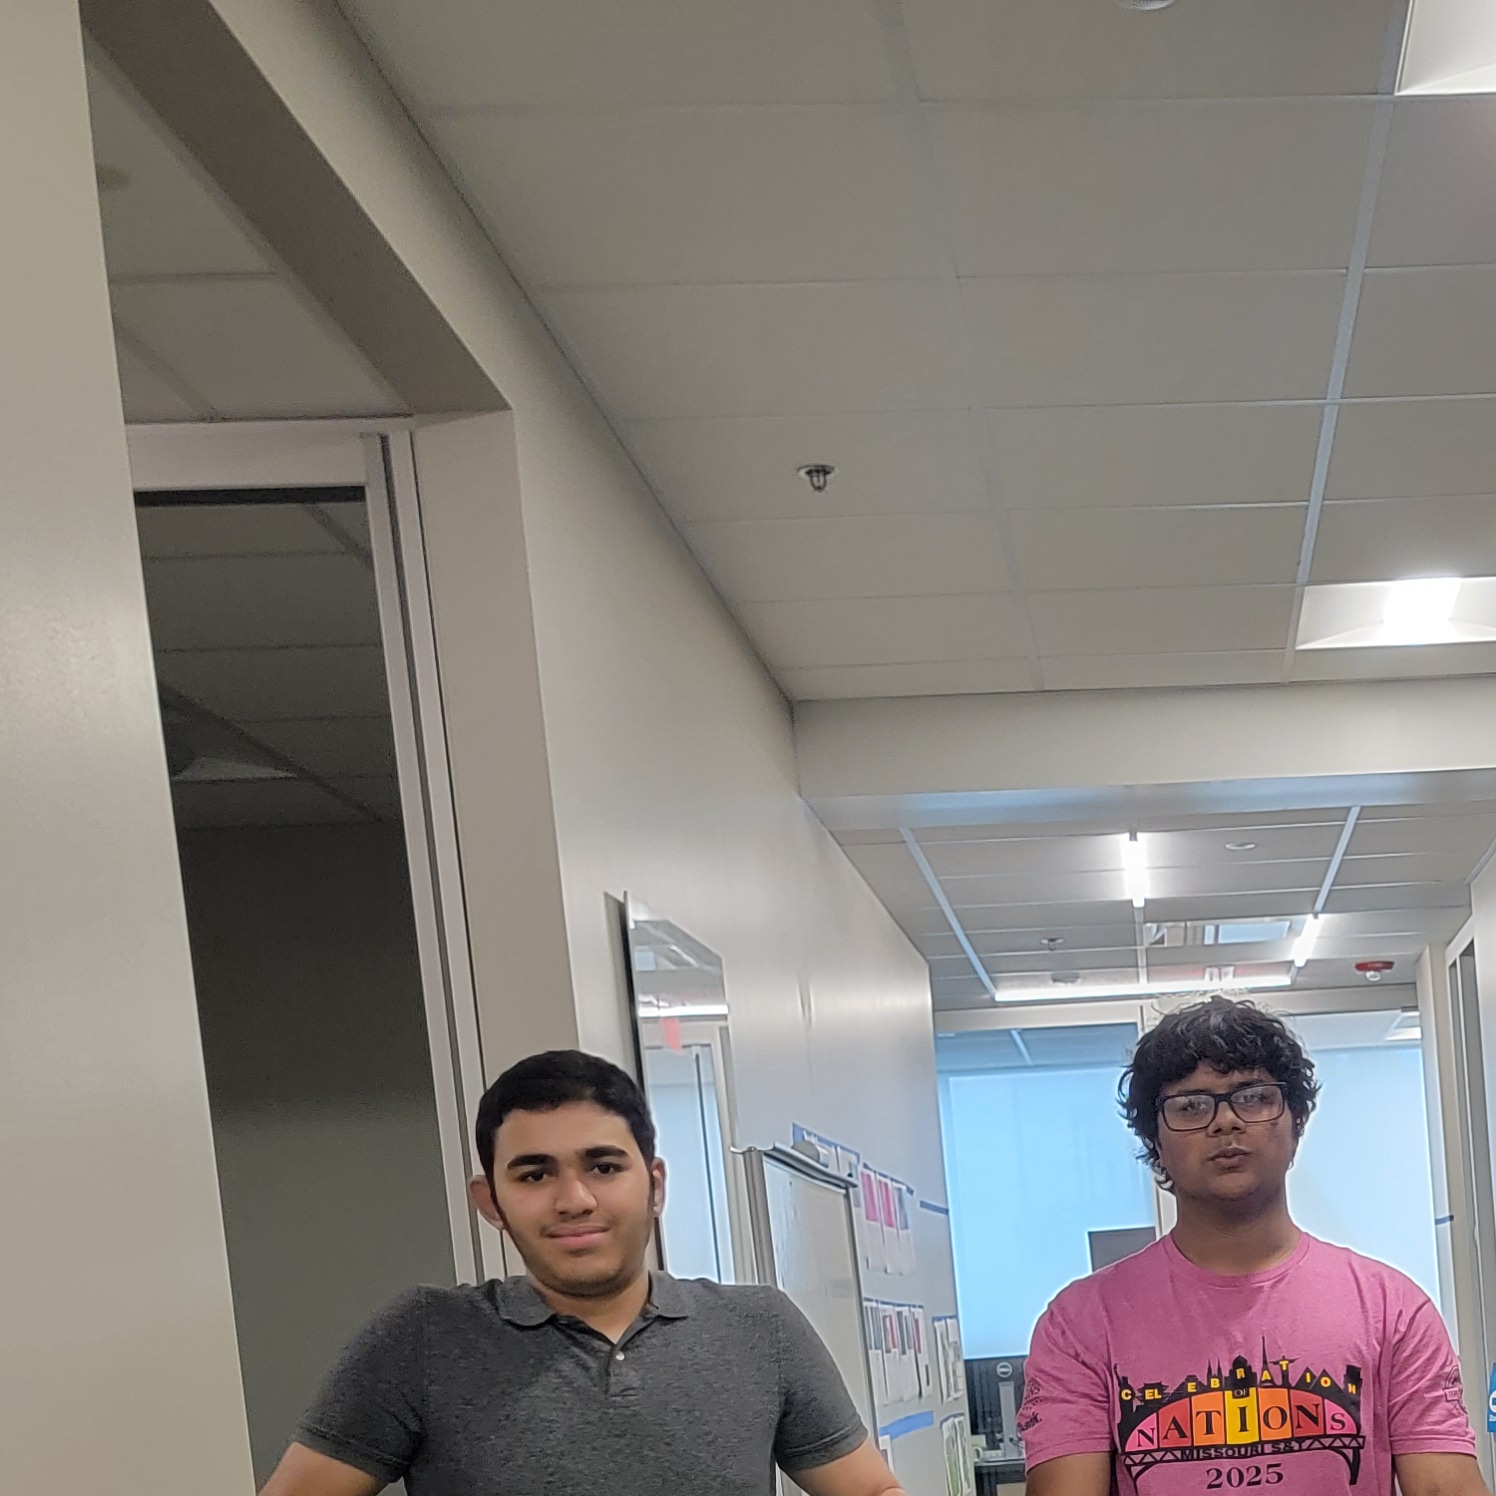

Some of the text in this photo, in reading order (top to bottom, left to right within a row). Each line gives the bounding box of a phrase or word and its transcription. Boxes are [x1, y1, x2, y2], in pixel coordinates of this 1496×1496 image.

[1233, 1388, 1249, 1398] OF
[1136, 1403, 1347, 1448] NATIONS
[1181, 1437, 1306, 1460] MISSOURI S&T
[1205, 1463, 1284, 1490] 2025
